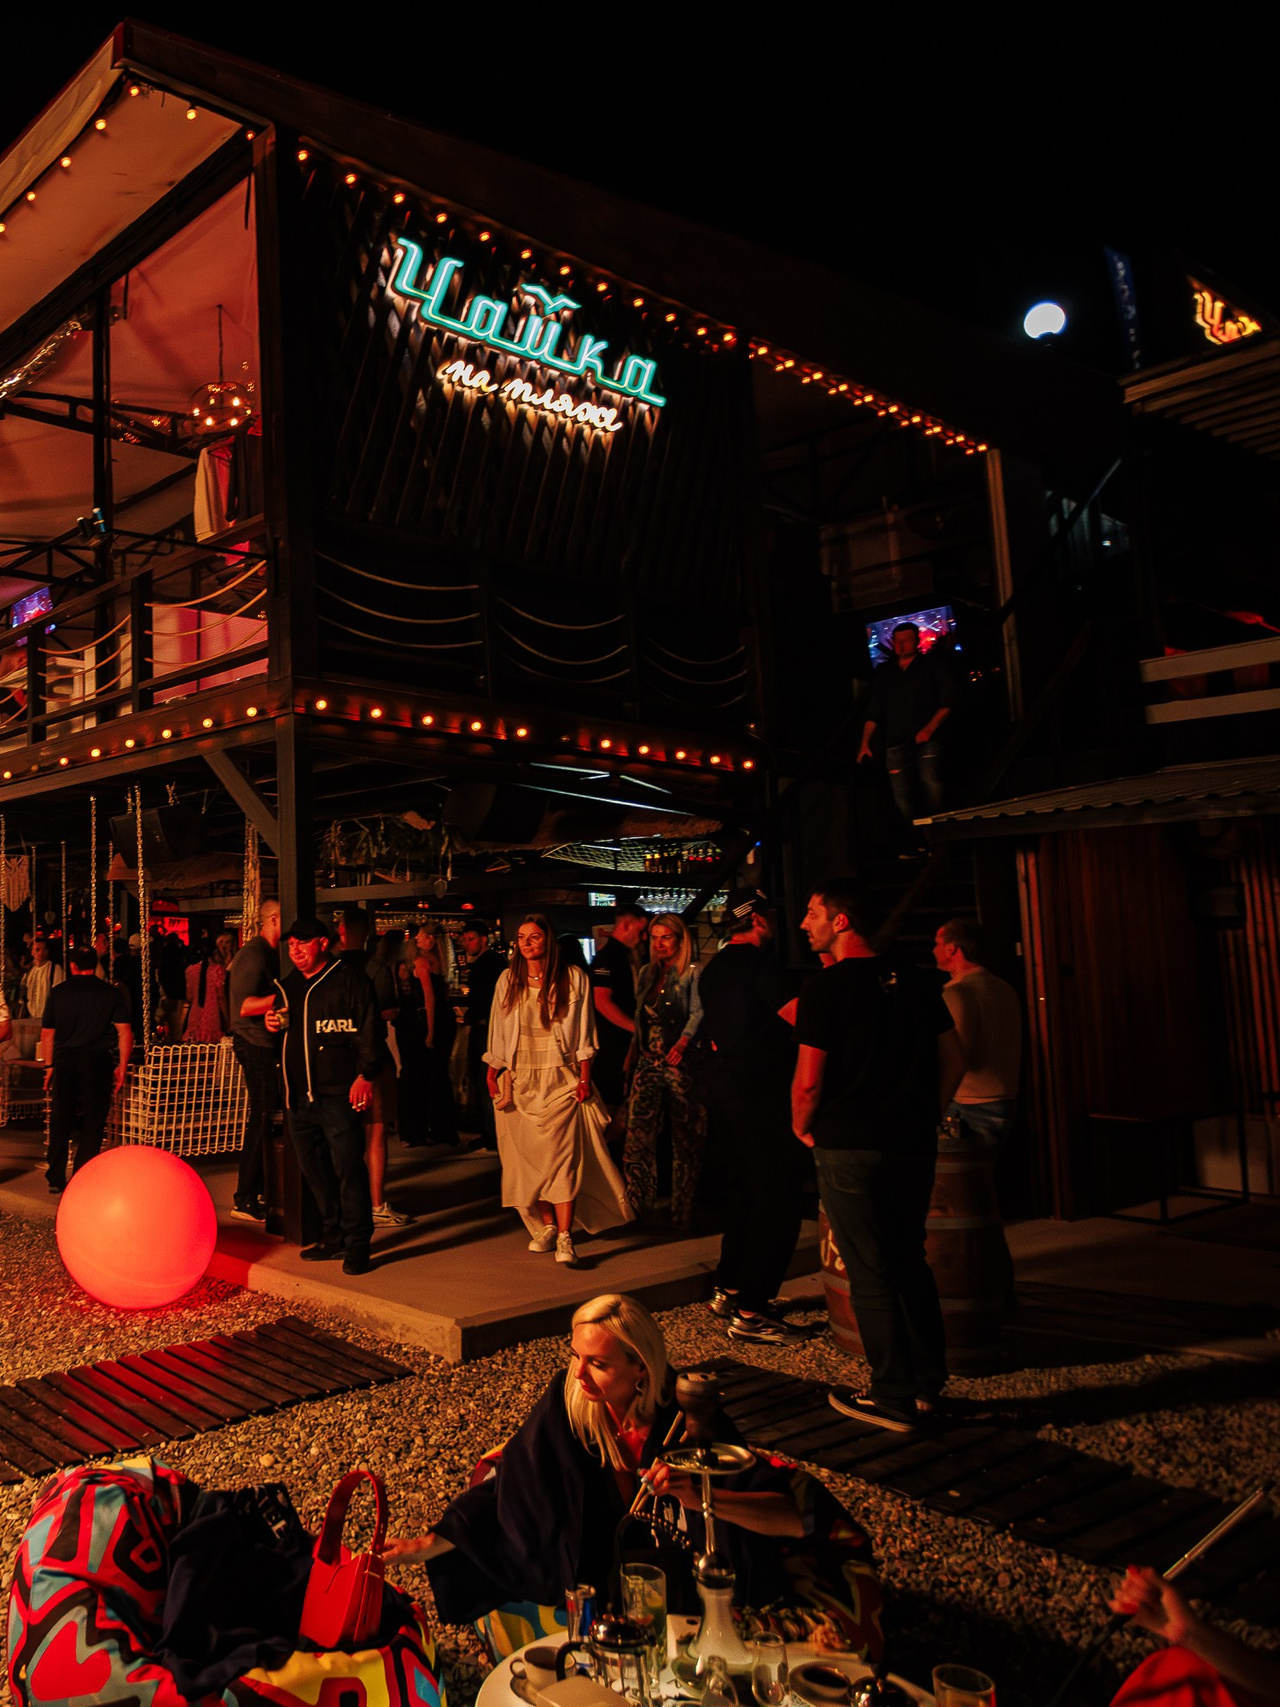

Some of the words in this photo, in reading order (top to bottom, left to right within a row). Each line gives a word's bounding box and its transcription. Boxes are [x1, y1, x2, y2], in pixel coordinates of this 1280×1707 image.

[395, 237, 667, 408] Чайка
[445, 360, 499, 393] на
[503, 378, 623, 432] пляже
[315, 1019, 358, 1034] KARL
